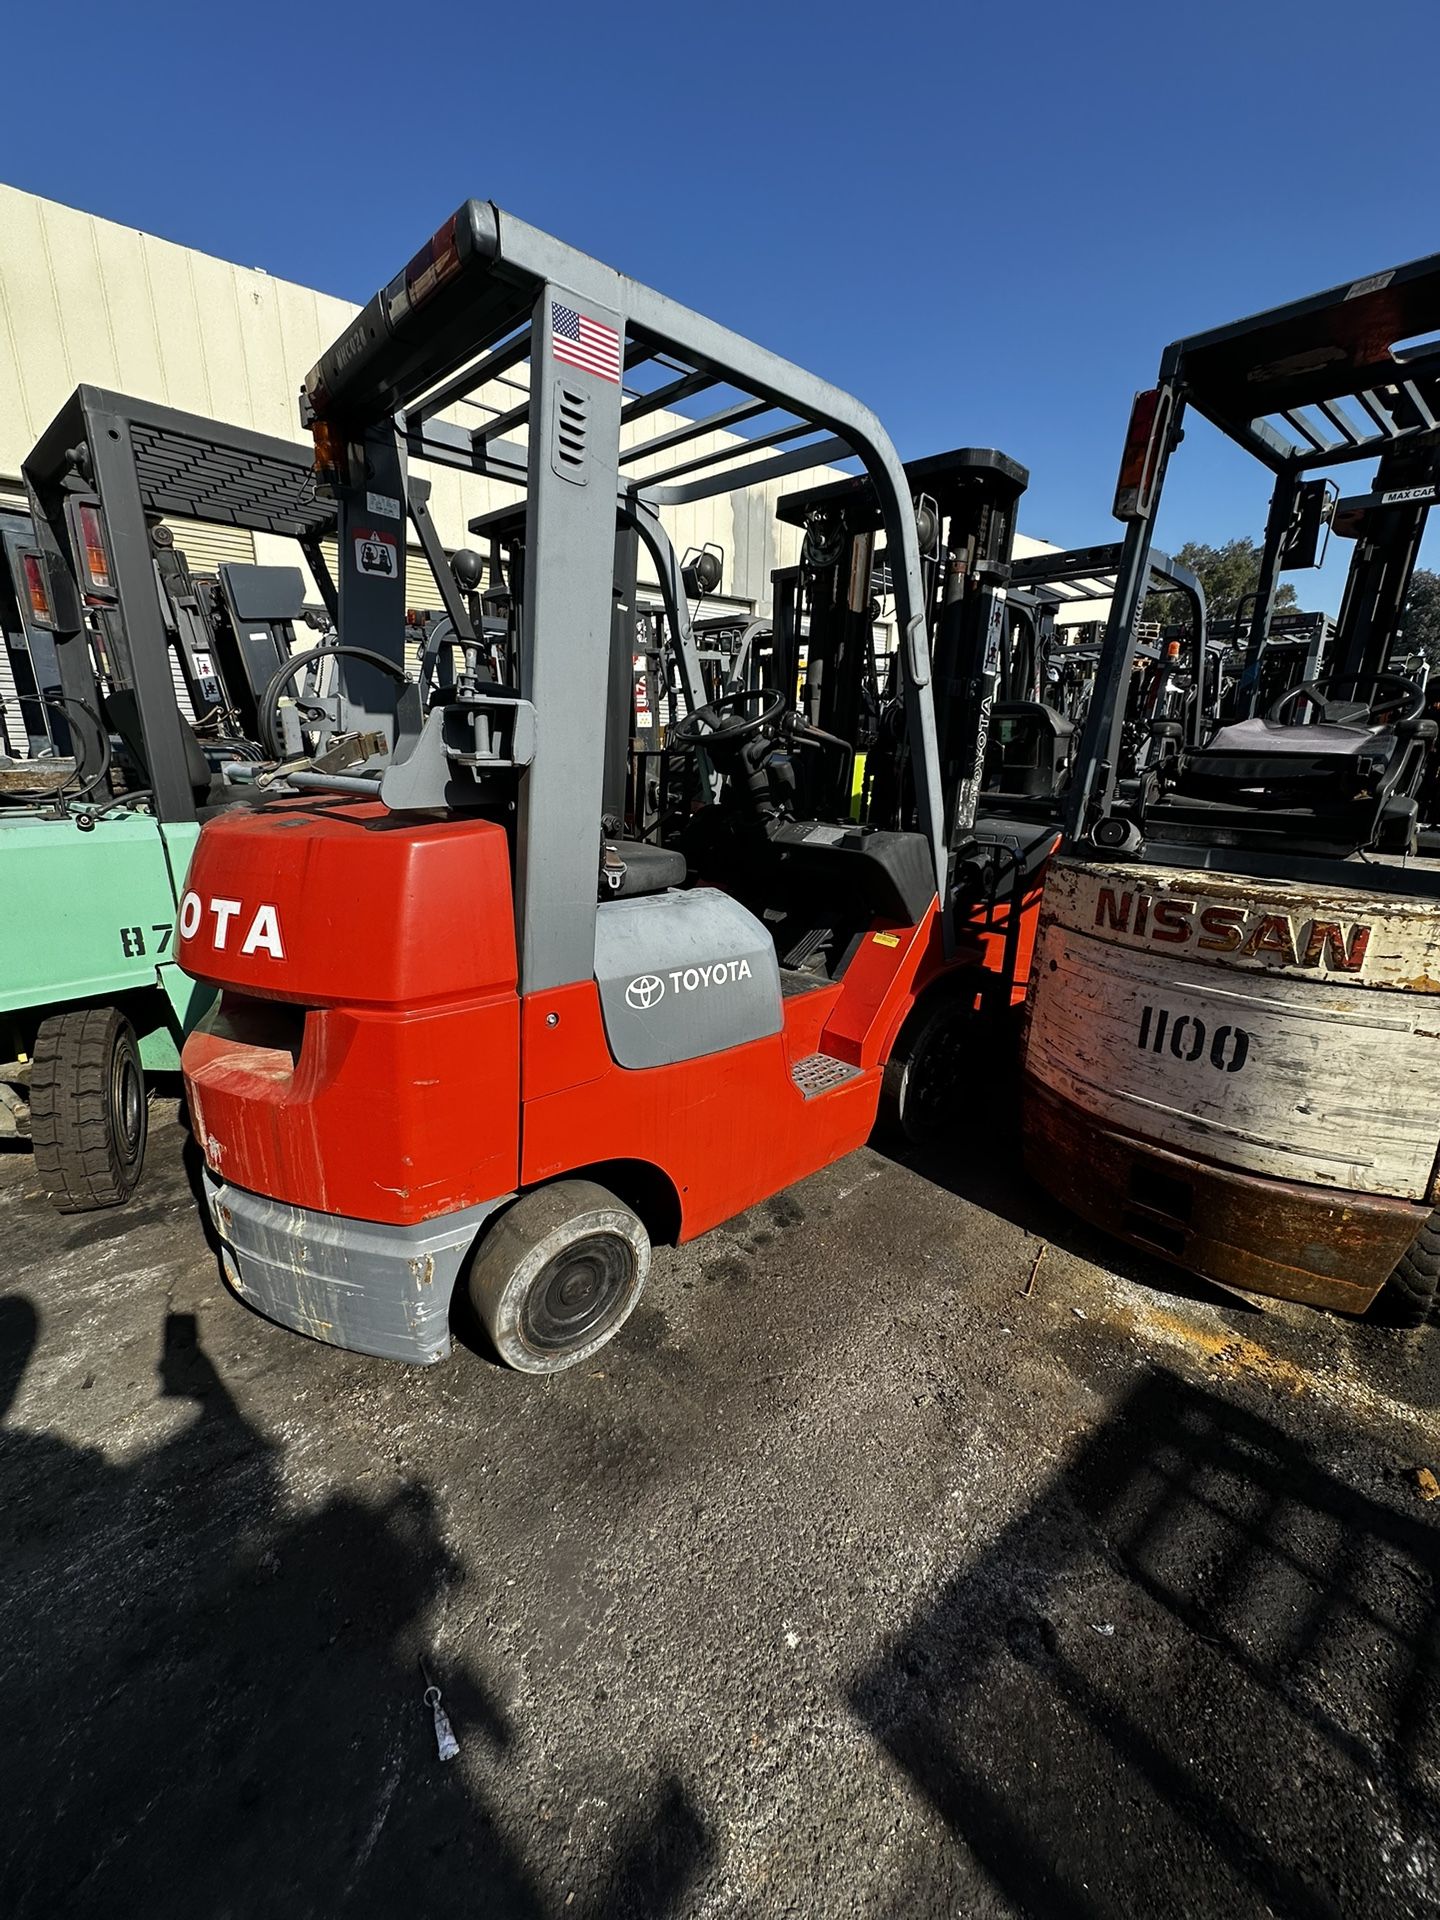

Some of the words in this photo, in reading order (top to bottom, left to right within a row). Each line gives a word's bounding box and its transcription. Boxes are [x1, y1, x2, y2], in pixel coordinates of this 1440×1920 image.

[1387, 492, 1411, 501] MAX
[1096, 887, 1372, 973] NISSAN
[668, 959, 753, 994] TOYOTA
[1137, 1006, 1250, 1073] 1100
